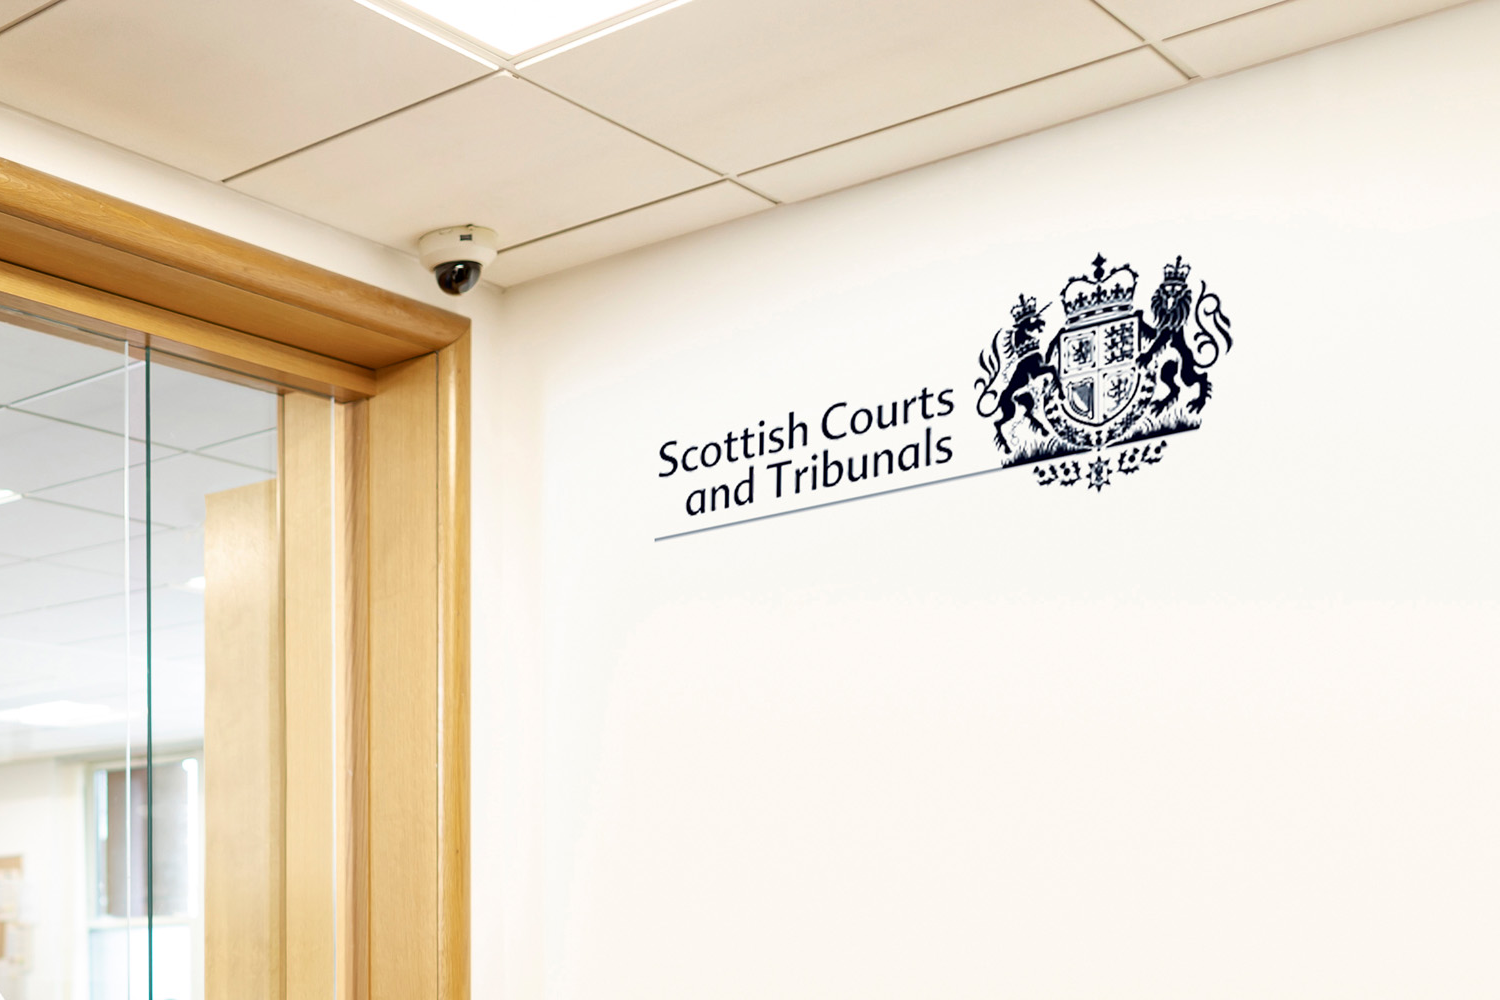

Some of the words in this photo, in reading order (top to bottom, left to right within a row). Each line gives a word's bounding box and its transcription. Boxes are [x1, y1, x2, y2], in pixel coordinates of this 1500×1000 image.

[658, 411, 808, 478] Scottish
[821, 387, 955, 440] Courts
[685, 465, 754, 516] and
[766, 427, 953, 498] Tribunals
